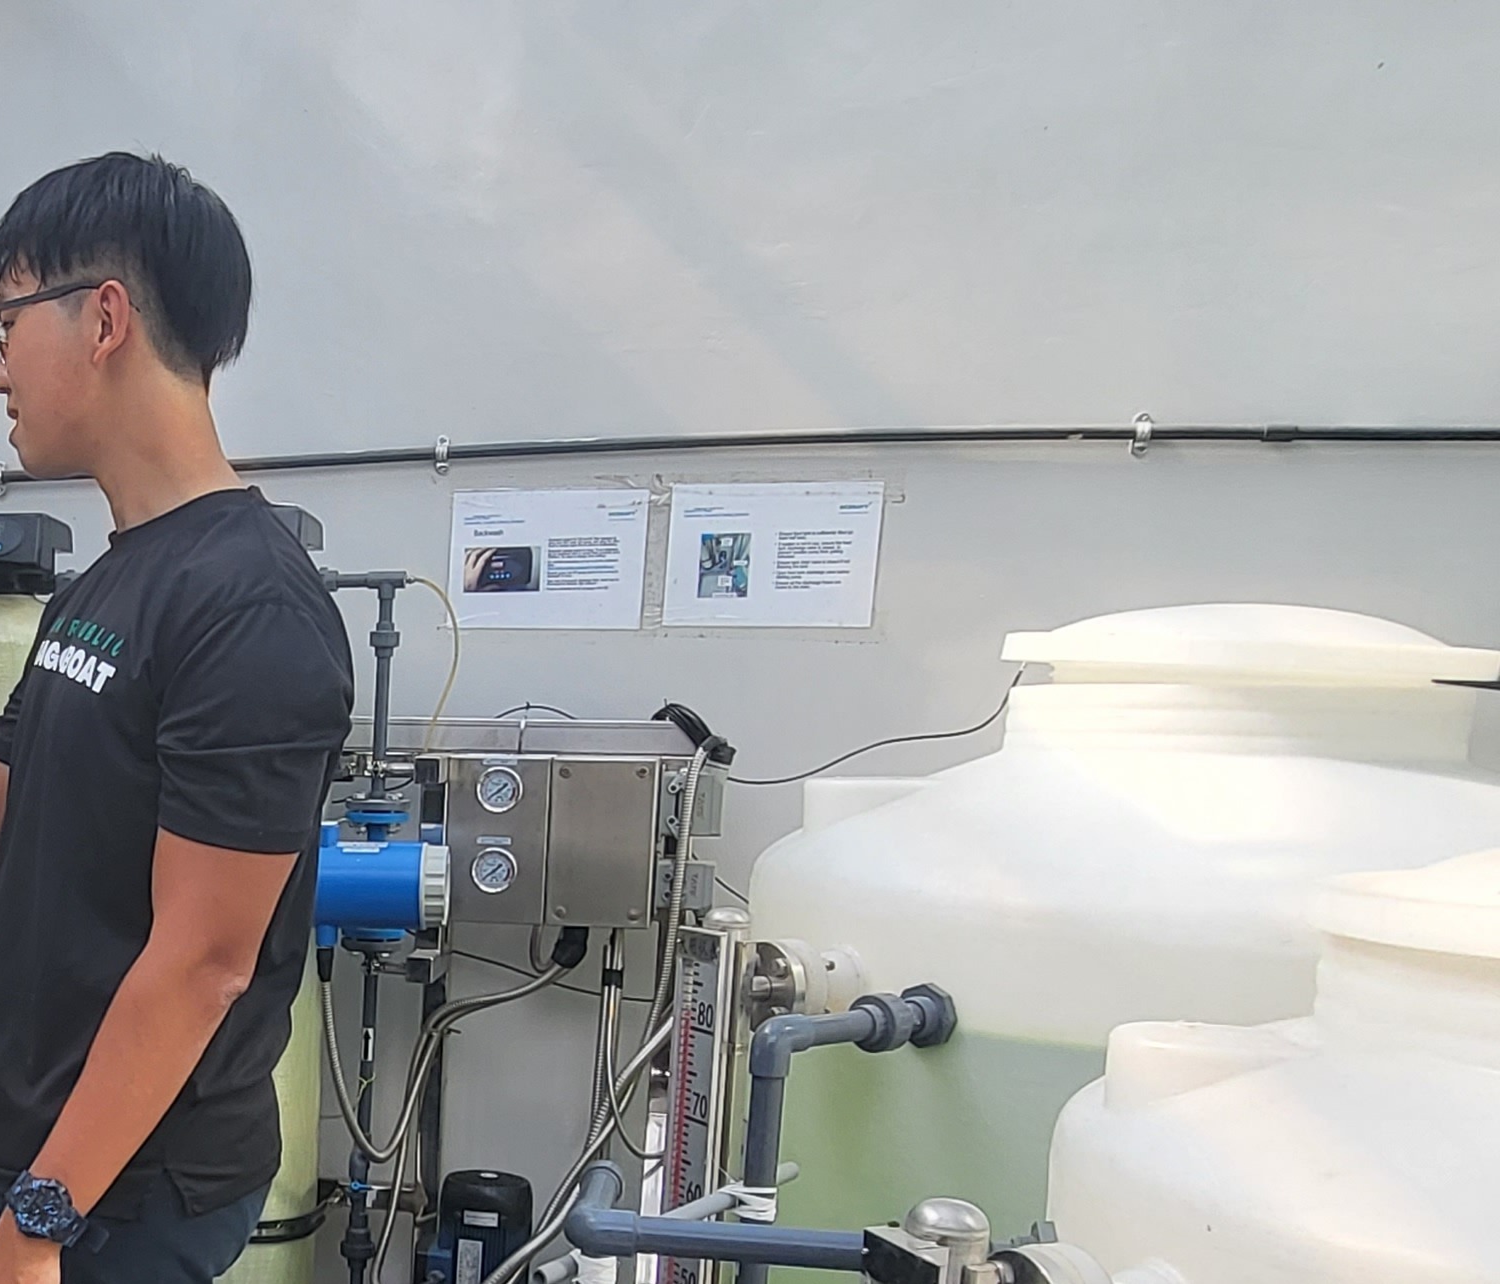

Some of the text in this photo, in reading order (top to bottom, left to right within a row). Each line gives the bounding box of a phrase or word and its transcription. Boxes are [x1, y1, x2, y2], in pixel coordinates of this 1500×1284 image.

[697, 1001, 714, 1028] 80
[692, 1091, 708, 1119] 70
[686, 1181, 702, 1203] 60
[681, 1267, 696, 1284] 50
